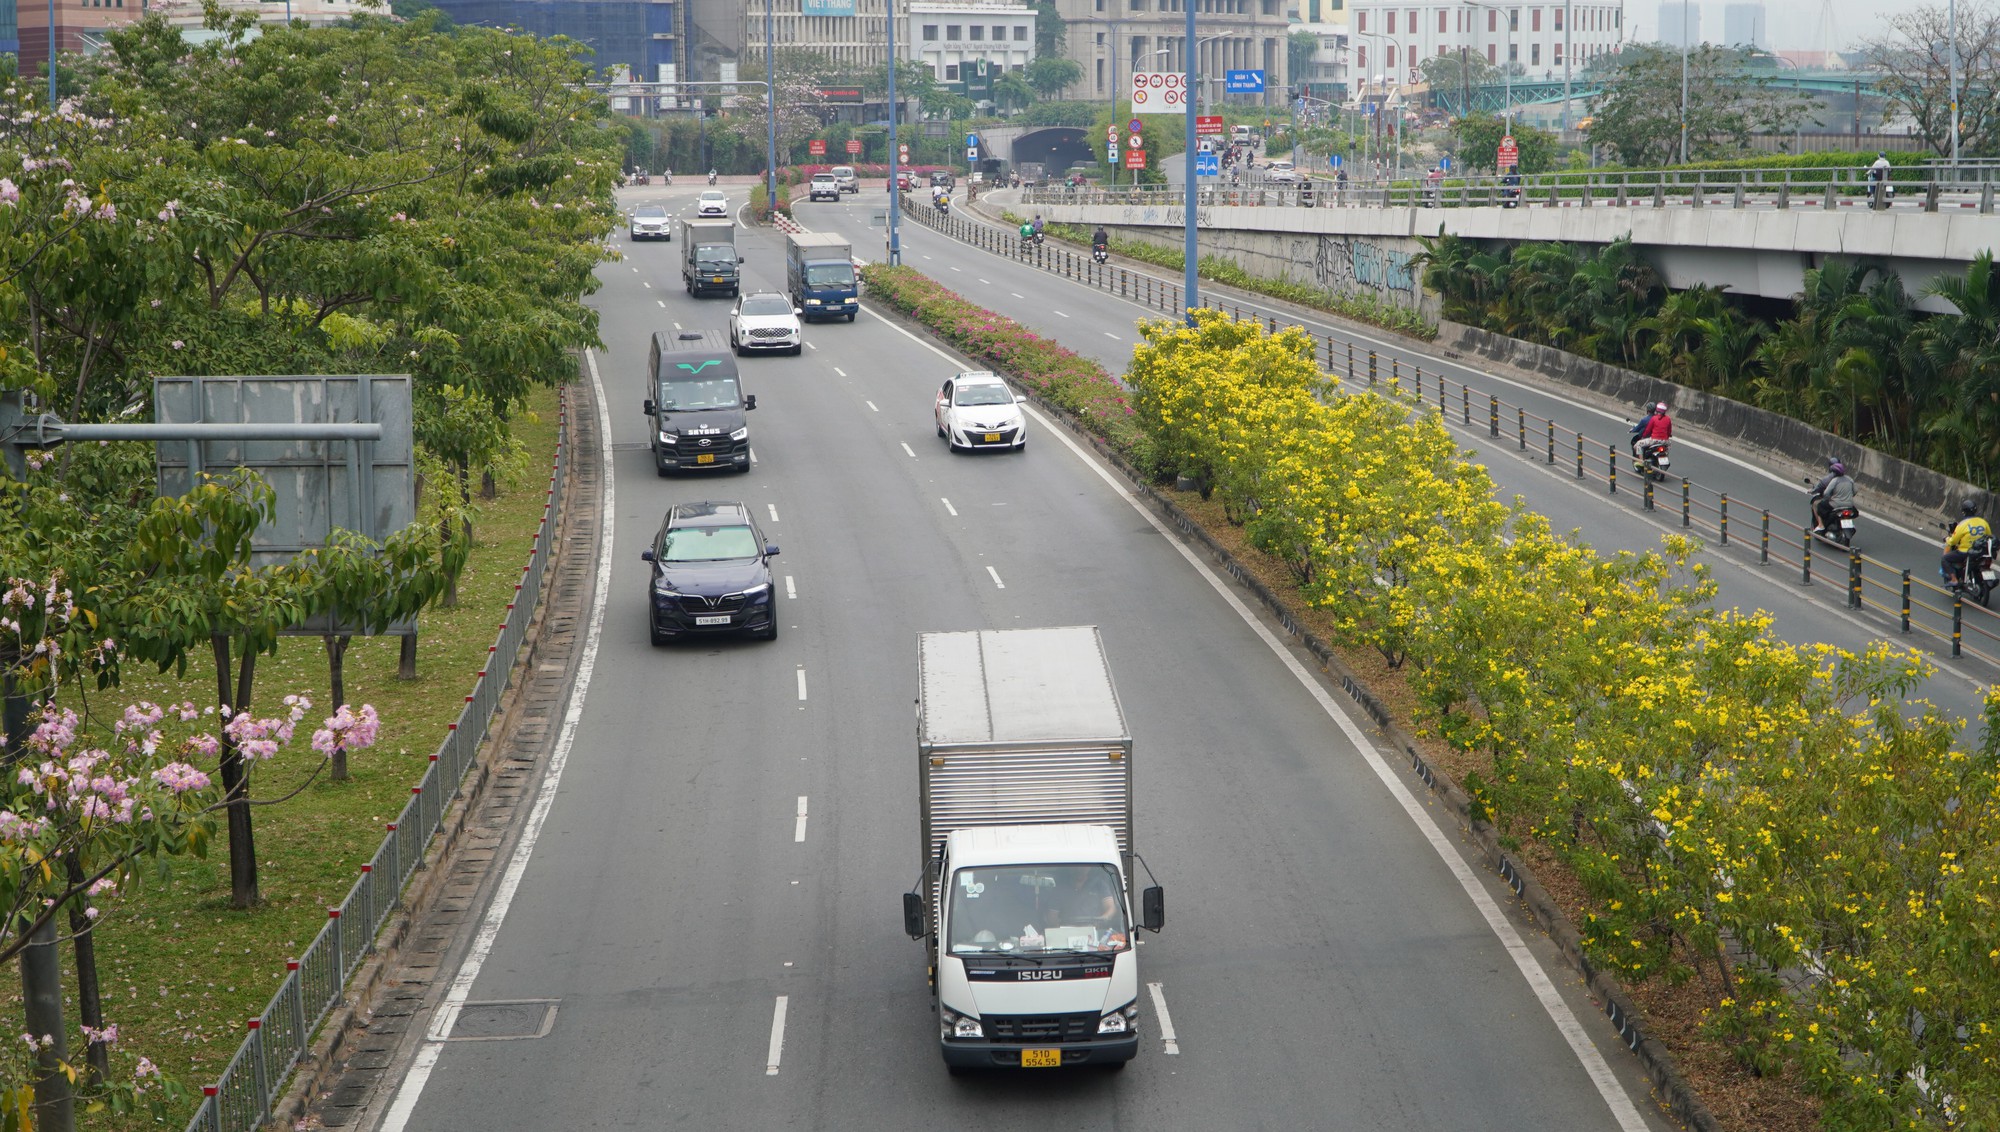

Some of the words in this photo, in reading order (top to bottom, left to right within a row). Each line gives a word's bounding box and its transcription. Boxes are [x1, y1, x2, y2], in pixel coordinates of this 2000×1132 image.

[1968, 524, 1985, 536] be
[1018, 970, 1062, 980] ISUZU
[1025, 1058, 1057, 1066] 554.55
